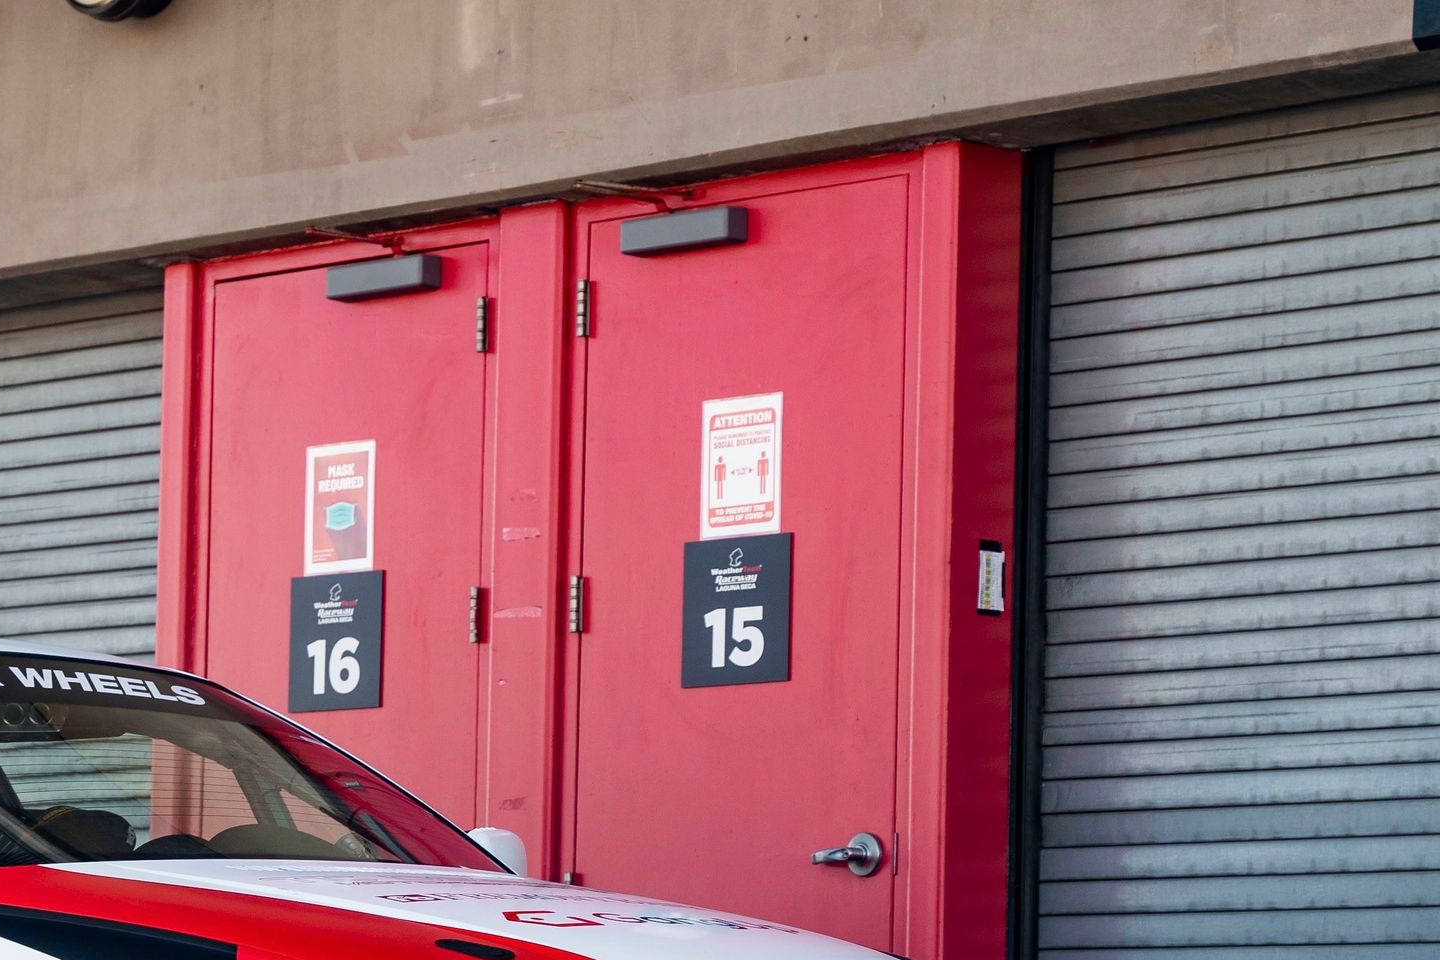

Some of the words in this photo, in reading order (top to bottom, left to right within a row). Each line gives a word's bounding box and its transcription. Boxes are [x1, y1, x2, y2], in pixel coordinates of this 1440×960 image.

[713, 410, 773, 429] ATTENTION
[713, 441, 735, 449] SOCIAL
[736, 436, 771, 447] DISTANCING
[327, 464, 355, 478] MASK
[318, 476, 364, 493] REQUIRED
[715, 508, 725, 516] TO
[725, 505, 753, 515] PREVENT
[715, 574, 758, 585] Raceway
[715, 585, 740, 593] LAGUNA
[317, 608, 355, 619] Raceway
[703, 605, 765, 668] 15
[306, 636, 361, 695] 16
[8, 666, 207, 706] WHEELS
